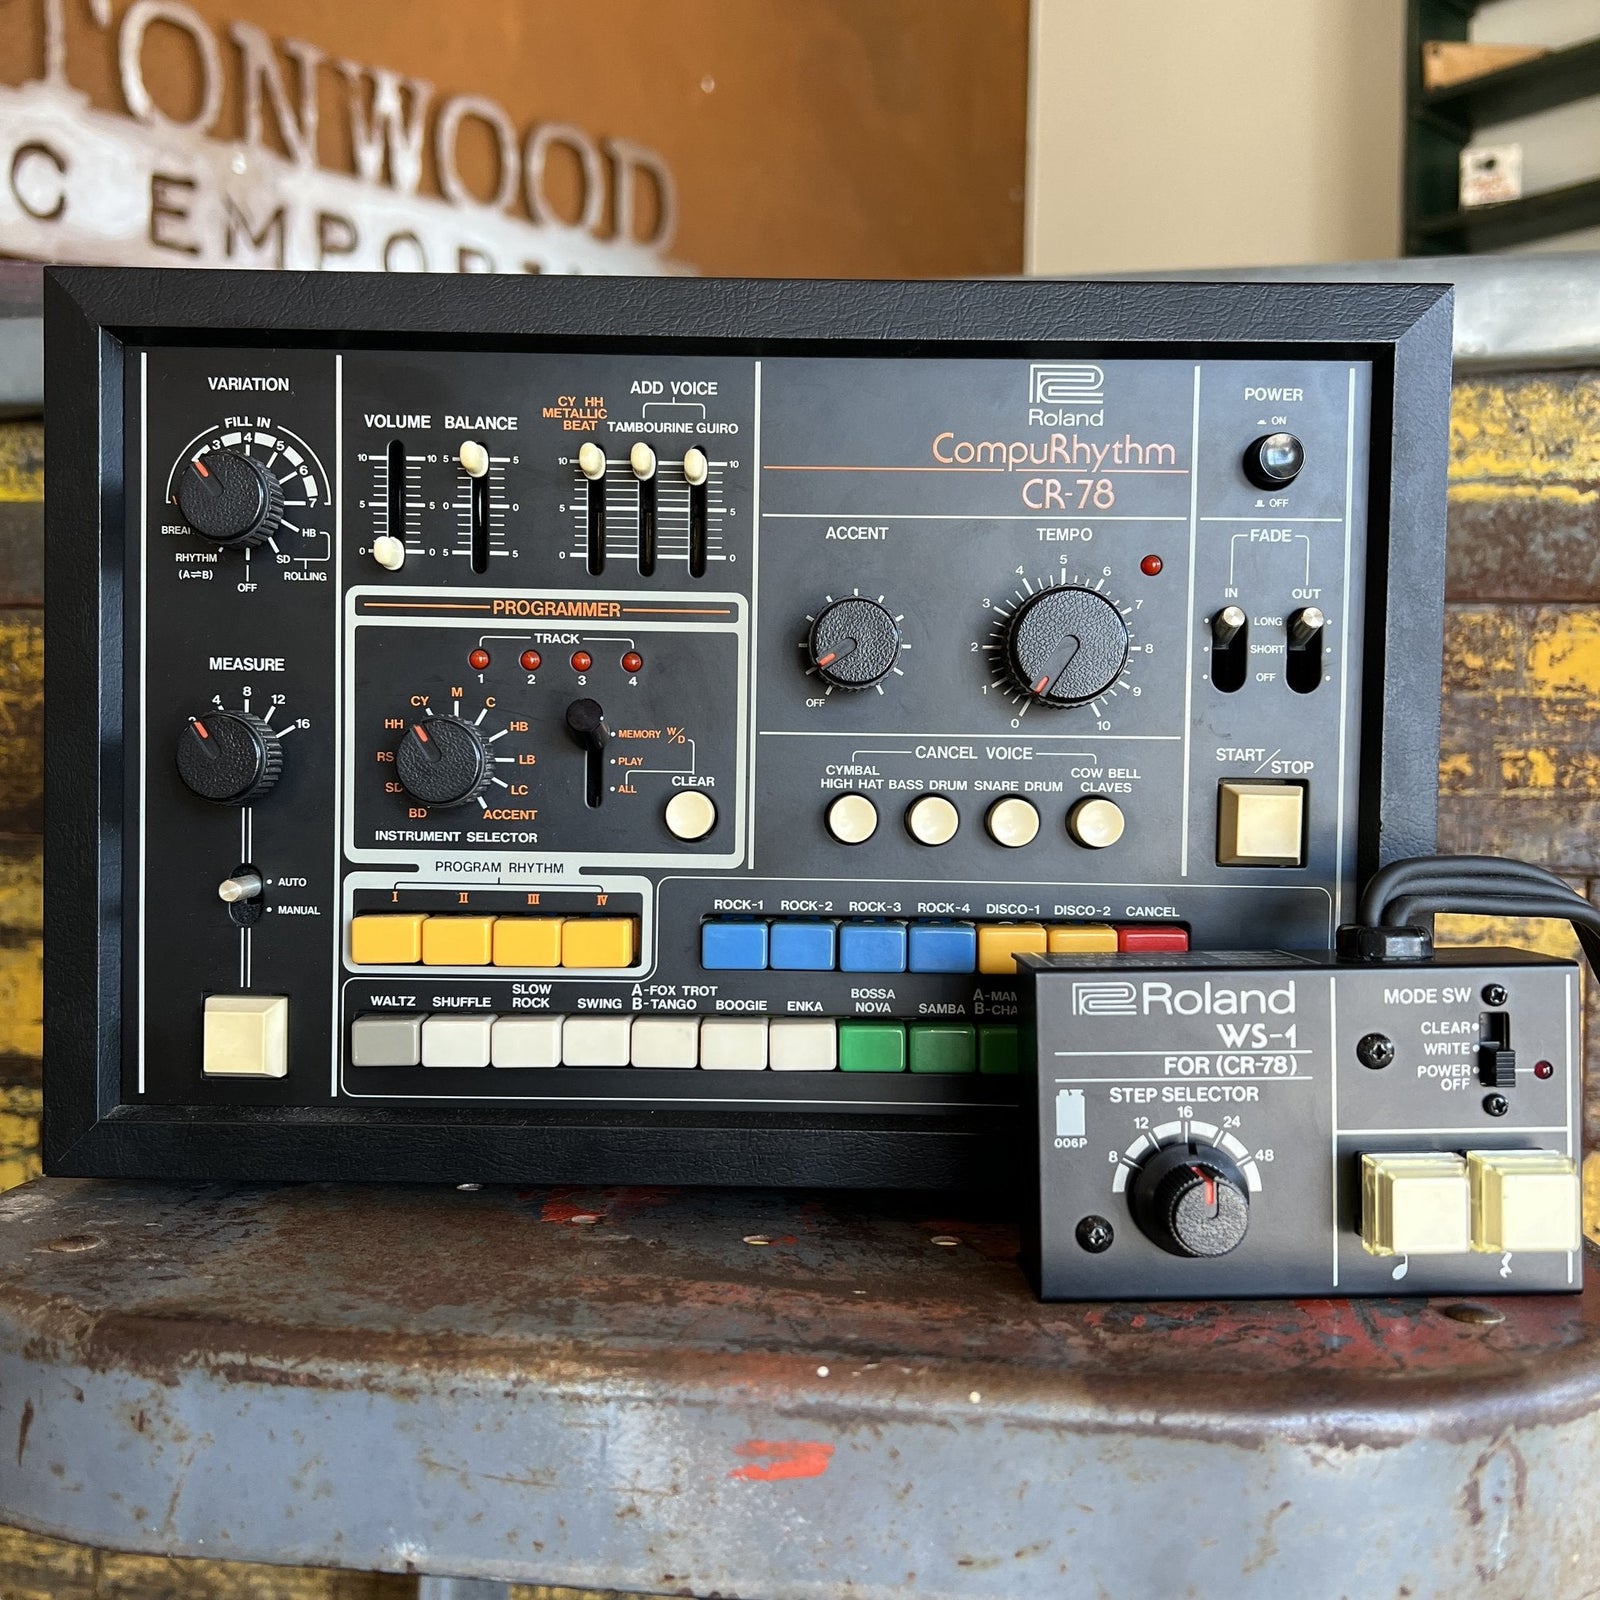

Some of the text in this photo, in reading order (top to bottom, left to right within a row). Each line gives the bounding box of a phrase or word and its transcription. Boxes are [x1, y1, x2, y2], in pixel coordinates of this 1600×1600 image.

[208, 377, 290, 391] VARIATION
[630, 381, 718, 395] ADD VOICE
[1245, 388, 1303, 402] POWER
[558, 396, 604, 407] CY HH
[543, 408, 608, 419] METALLIC
[1029, 408, 1104, 427] Roland
[224, 416, 271, 428] FILL IN
[364, 414, 518, 430] VOLUME BALANCE
[563, 420, 598, 431] BEAT
[1271, 416, 1287, 425] ON
[607, 421, 739, 434] TAMBOURINE GUIRO
[243, 432, 252, 442] 4
[212, 440, 221, 449] 3
[276, 441, 284, 450] 5
[357, 454, 367, 462] 10
[932, 432, 1175, 473] CompuRhythm
[427, 455, 437, 463] 10
[558, 457, 567, 465] 10
[299, 465, 308, 475] 6
[729, 461, 739, 469] 10
[1022, 478, 1115, 510] CR-78
[308, 498, 317, 508] 7
[559, 504, 566, 512] 5
[1269, 499, 1289, 508] OFF
[302, 529, 316, 537] HB
[825, 527, 1093, 541] ACCENT TEMPO
[1250, 529, 1292, 543] FADE
[359, 547, 366, 555] 0
[175, 553, 217, 562] RHYTHM
[276, 554, 290, 563] SD
[1060, 554, 1068, 565] 5
[1015, 565, 1024, 575] 4
[1103, 566, 1111, 576] 6
[284, 572, 327, 581] ROLLING
[237, 583, 257, 592] OFF
[1225, 588, 1321, 600] IN OUT
[493, 600, 621, 617] PROGRAMMER
[982, 598, 990, 608] 3
[1135, 600, 1144, 610] 7
[1254, 617, 1283, 626] LONG
[534, 633, 580, 644] TRACK
[970, 642, 978, 652] 2
[1145, 644, 1154, 654] 8
[1250, 645, 1284, 654] SHORT
[209, 657, 285, 672] MEASURE
[477, 674, 485, 684] 1
[527, 674, 536, 685] 2
[577, 675, 587, 686] 3
[628, 676, 638, 686] 4
[1256, 673, 1276, 682] OFF
[243, 686, 252, 696] 8
[451, 687, 463, 696] M
[982, 685, 988, 695] 1
[1133, 686, 1141, 696] 9
[212, 694, 221, 705] 4
[271, 694, 286, 705] 12
[411, 696, 429, 706] CY
[485, 697, 496, 707] C
[806, 698, 826, 708] OFF
[295, 719, 310, 729] 16
[384, 719, 403, 729] HH
[510, 721, 528, 731] HB
[1010, 718, 1020, 729] 0
[1097, 721, 1111, 731] 10
[618, 730, 661, 738] MEMORY
[376, 752, 394, 762] RS
[915, 746, 1033, 760] CANCEL VOICE
[519, 755, 536, 765] LB
[618, 757, 643, 766] PLAY
[826, 765, 880, 776] CYMBAL
[1070, 768, 1141, 779] COW BELL
[671, 777, 715, 786] CLEAR
[820, 778, 884, 790] HIGH HAT
[888, 779, 968, 791] BASS DRUM
[974, 780, 1063, 792] SNARE DRUM
[1080, 781, 1132, 793] CLAVES
[511, 785, 528, 795] LC
[618, 785, 637, 793] ALL
[409, 808, 427, 818] BD
[483, 809, 538, 820] ACCENT
[375, 830, 538, 843] INSTRUMENT SELECTOR
[435, 861, 564, 874] PROGRAM RHYTHM
[278, 877, 307, 887] AUTO
[278, 906, 320, 915] MANUAL
[714, 899, 1180, 918] ROCK-1 ROCK-2 ROCK-3 ROCK-4 DISCO-1 DISCO-2 CANCEL
[512, 984, 552, 995] SLOW
[682, 985, 718, 997] TROT
[850, 989, 896, 1000] BOSSA
[1142, 980, 1296, 1016] Roland
[1384, 987, 1472, 1004] MODE SW
[370, 995, 491, 1008] WALTZ SHUFFLE
[512, 997, 550, 1009] ROCK
[577, 999, 622, 1010] SWING
[716, 1000, 823, 1012] BOOGIE ENKA
[855, 1002, 891, 1014] NOVA
[918, 1003, 965, 1014] SAMBA
[1421, 1021, 1470, 1034] CLEAR
[1216, 1023, 1297, 1049] WS-1
[1424, 1042, 1470, 1055] WRITE
[1164, 1055, 1297, 1077] FOR (CR-78)
[1417, 1064, 1470, 1078] POWER
[1441, 1078, 1470, 1090] OFF
[1109, 1086, 1259, 1103] STEP SELECTOR
[1177, 1106, 1193, 1118] 16
[1134, 1117, 1149, 1129] 12
[1223, 1116, 1241, 1128] 24
[1054, 1137, 1088, 1148] 006P
[1109, 1150, 1118, 1163] 8
[1255, 1149, 1274, 1162] 48
